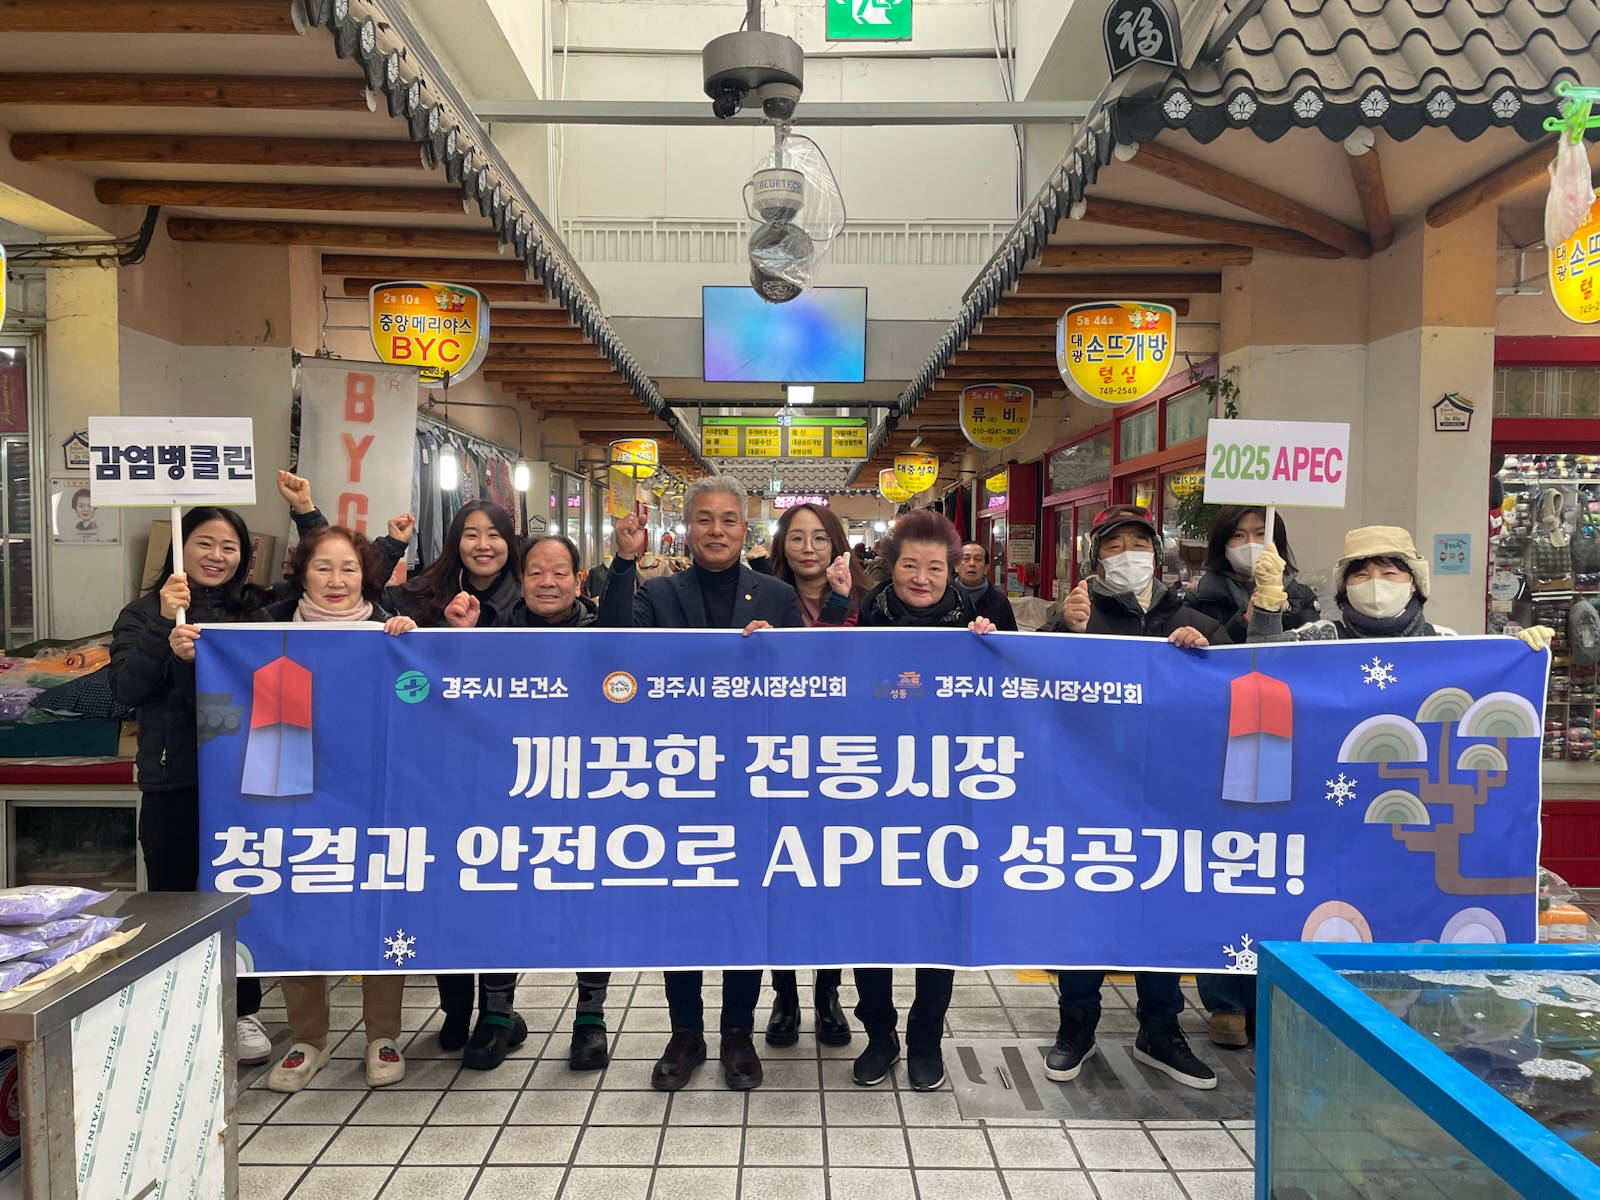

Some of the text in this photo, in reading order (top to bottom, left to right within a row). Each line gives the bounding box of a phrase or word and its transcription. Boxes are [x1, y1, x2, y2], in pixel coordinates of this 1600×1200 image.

[1115, 7, 1163, 57] 福
[380, 313, 472, 335] 중앙메리야스
[1076, 315, 1115, 326] 5동 44호
[391, 335, 461, 363] BYC
[1071, 333, 1084, 363] 대광
[1086, 333, 1168, 362] 손뜨개방
[1099, 387, 1138, 395] 749-2549
[972, 407, 986, 422] 류
[1003, 407, 1016, 423] 비
[90, 445, 253, 481] 감염병클린
[897, 464, 936, 476] 대중상회
[1211, 443, 1343, 484] 2025 APEC
[441, 676, 569, 700] 경주시 보건소
[646, 675, 706, 699] 경주시
[711, 675, 848, 699] 중앙시장상인회
[935, 675, 994, 699] 경주시
[1000, 676, 1144, 705] 성동시장상인회
[508, 733, 1025, 801] 깨끗한 전통시장
[211, 823, 1306, 897] 청결과 안전으로 APEC 성공기원!
[136, 1030, 160, 1115] STAINLESS
[78, 1091, 104, 1183] STAINLESS
[162, 1082, 184, 1165] STAINLESS
